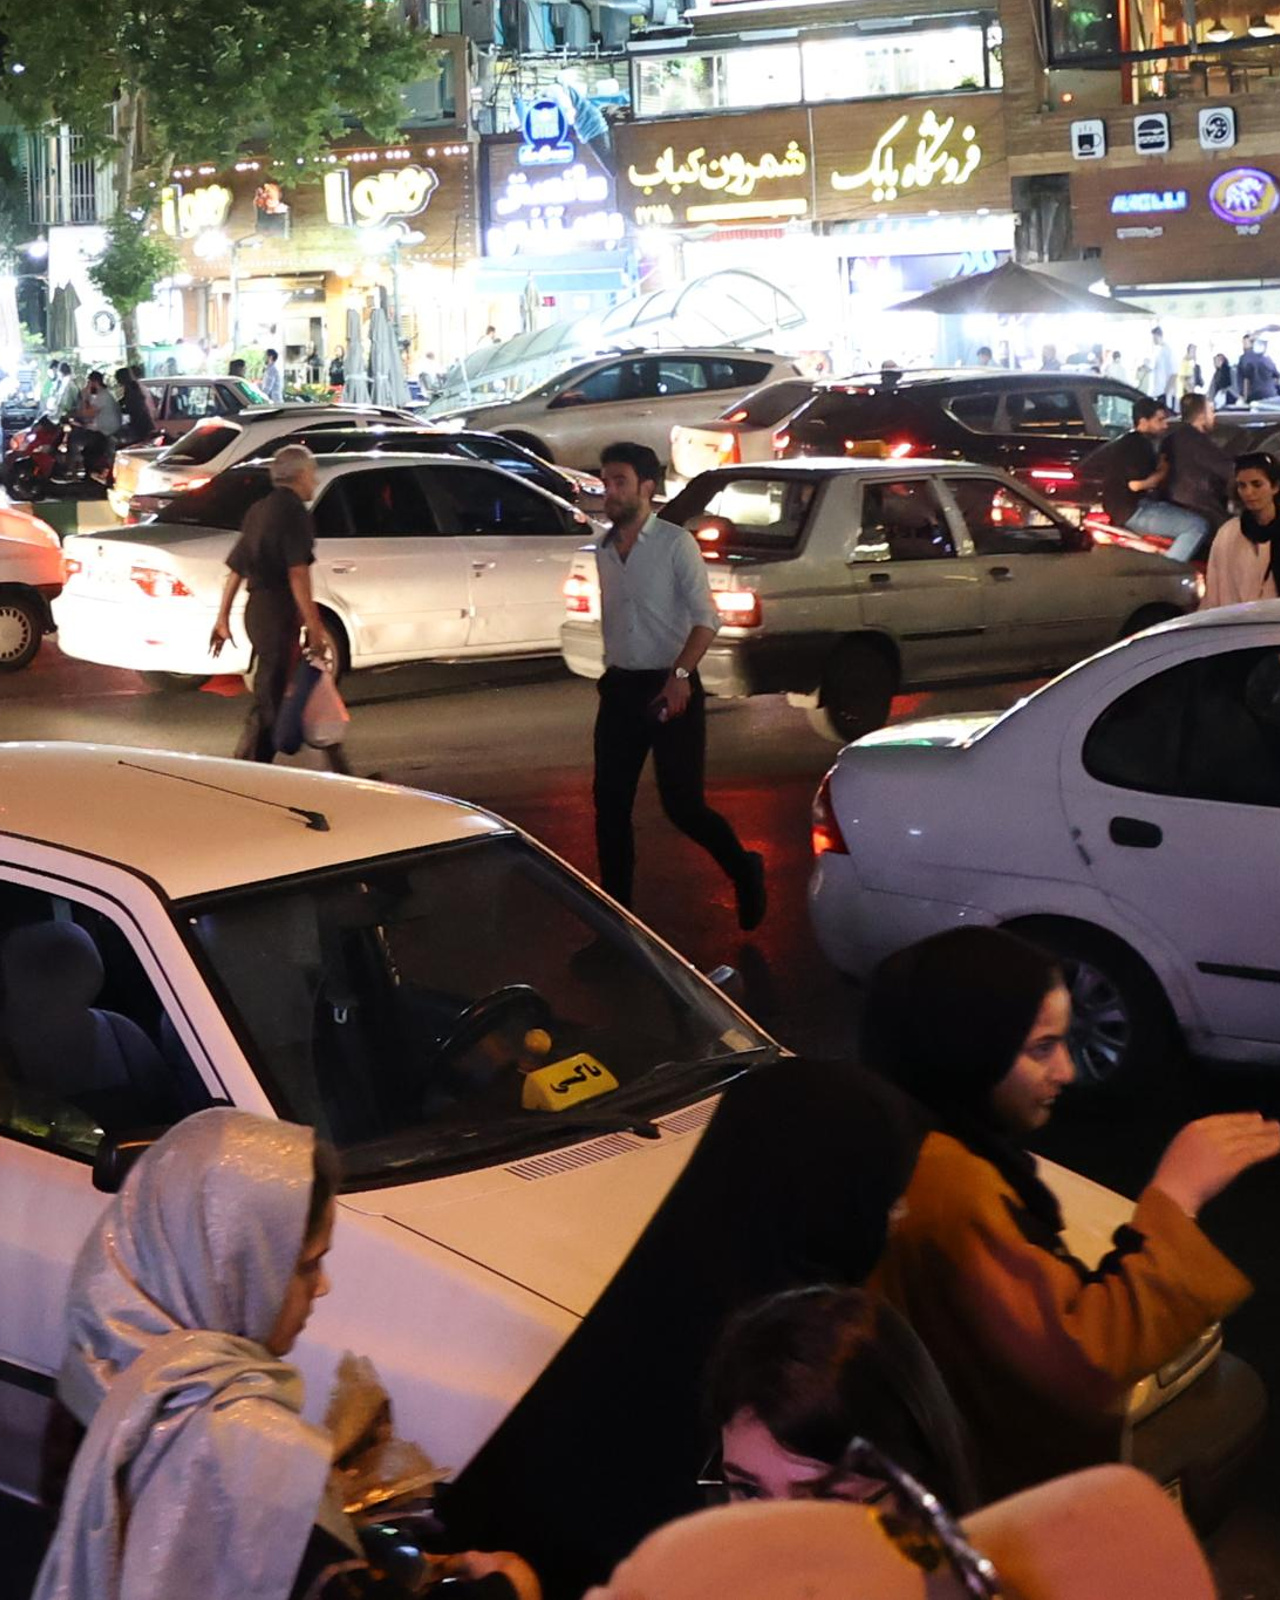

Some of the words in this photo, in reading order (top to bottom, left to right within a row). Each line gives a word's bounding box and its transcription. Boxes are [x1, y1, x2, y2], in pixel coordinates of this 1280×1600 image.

[628, 146, 705, 196] کباب
[699, 140, 807, 196] شمرون
[901, 109, 982, 185] فروشگاه
